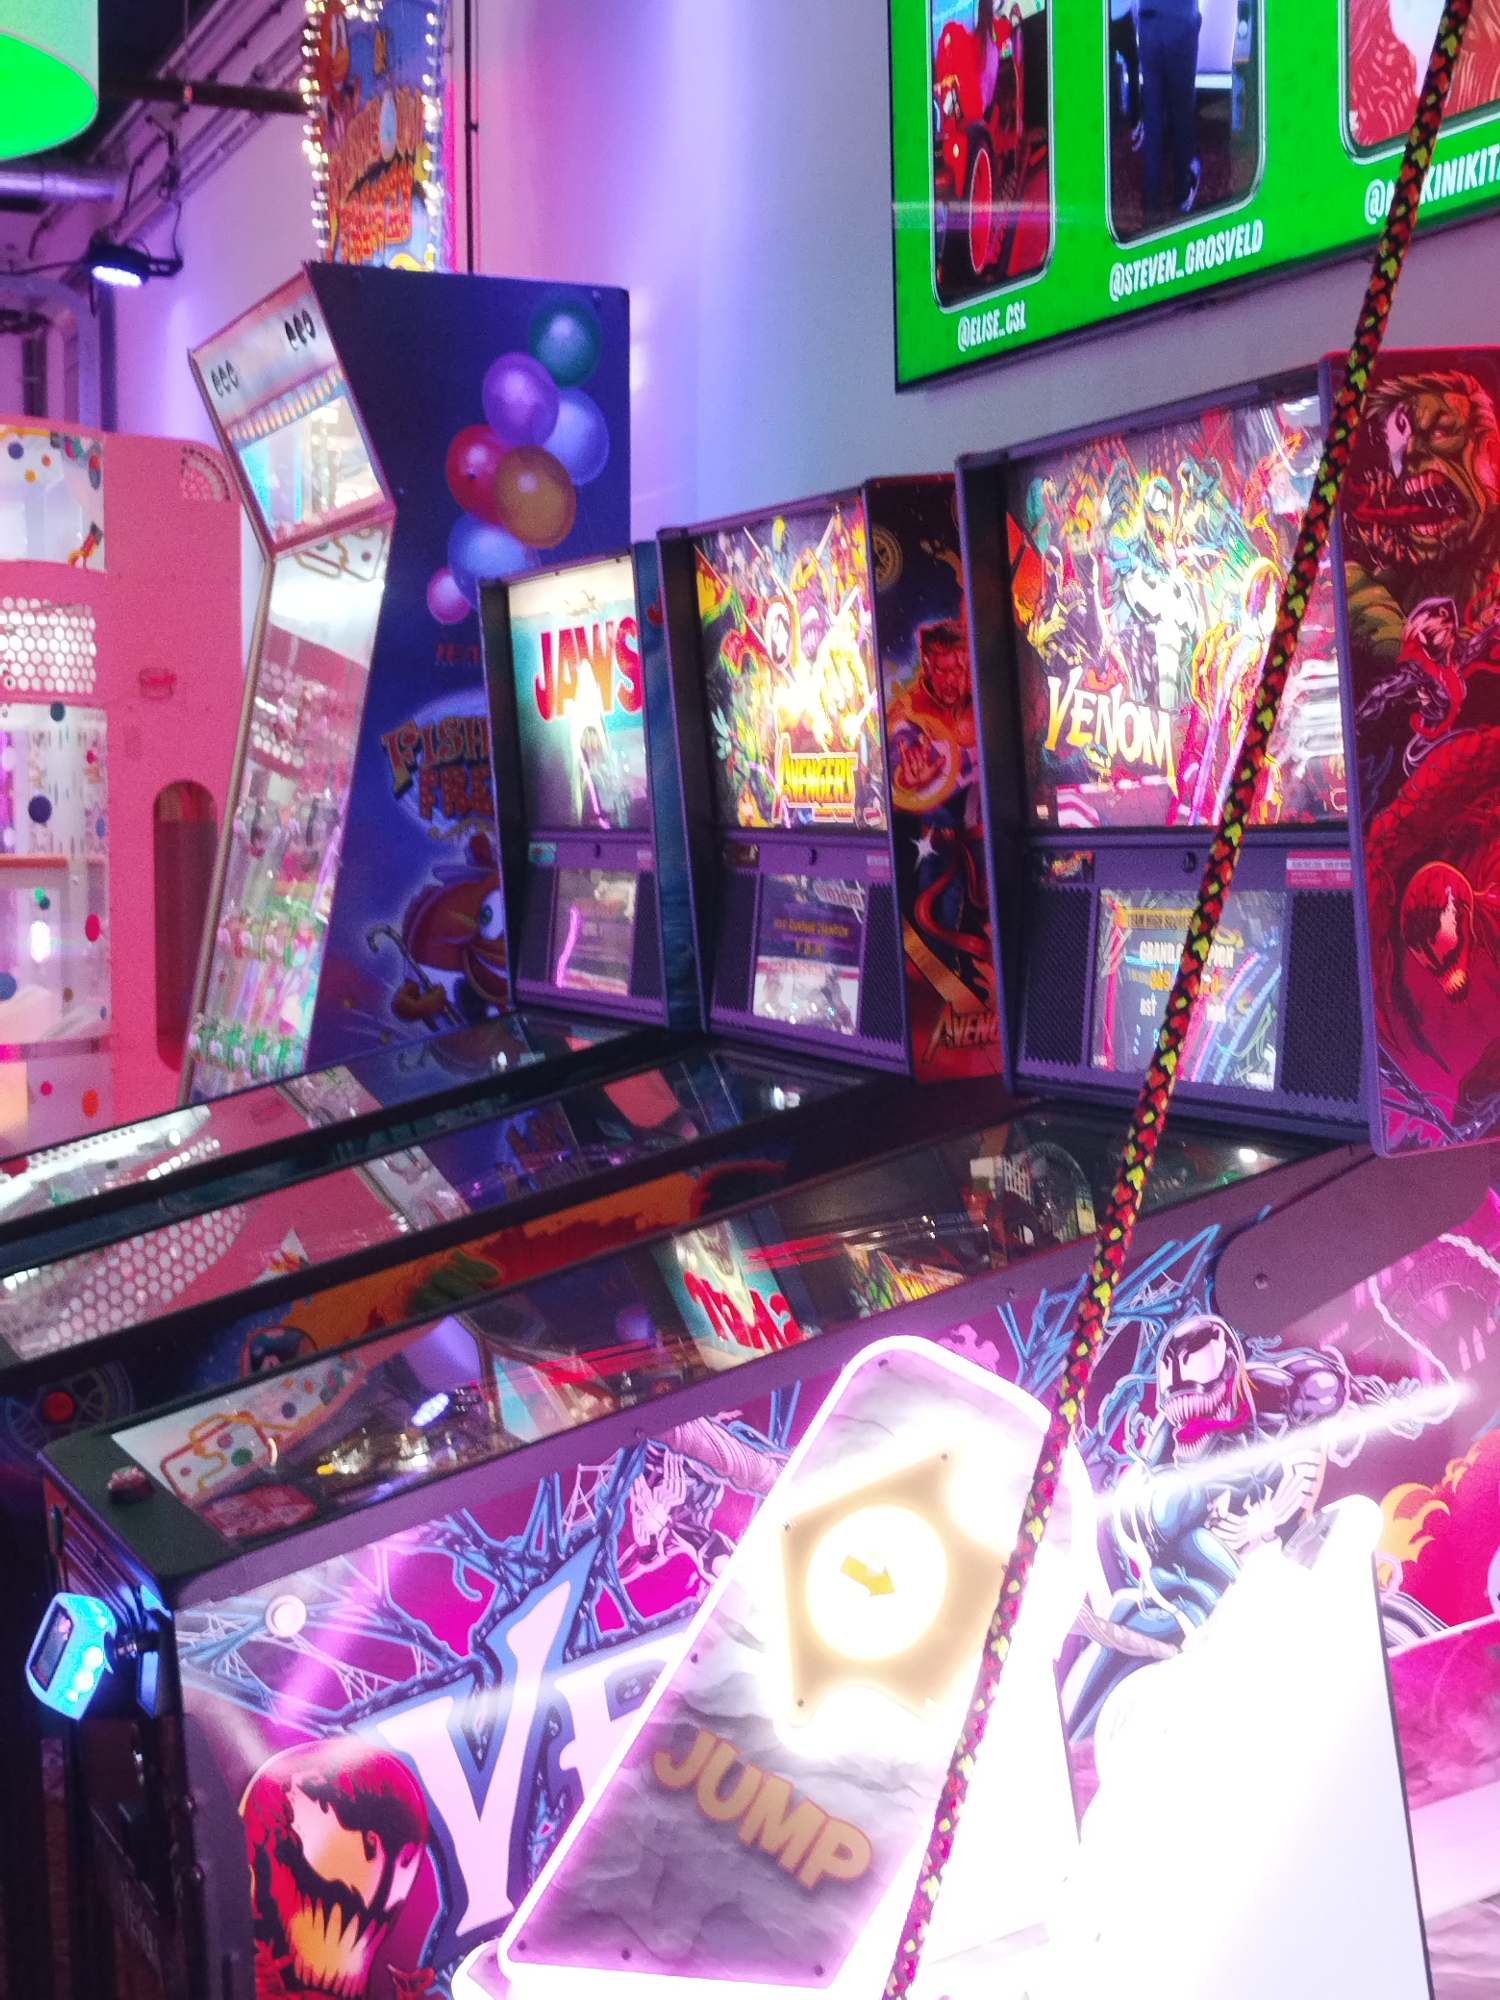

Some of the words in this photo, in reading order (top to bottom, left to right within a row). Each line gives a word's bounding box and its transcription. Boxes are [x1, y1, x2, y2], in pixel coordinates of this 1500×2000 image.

[1364, 143, 1500, 225] @KINIKIT
[1109, 219, 1264, 302] @STEVEN_GROSVELD
[957, 299, 1027, 352] @ELISE_CSL
[533, 614, 644, 722] JAWS
[1044, 665, 1179, 800] VENOM
[419, 763, 495, 819] FRE
[1140, 940, 1175, 964] GRAND
[1177, 942, 1235, 968] CPION
[653, 1727, 872, 1890] JUMP
